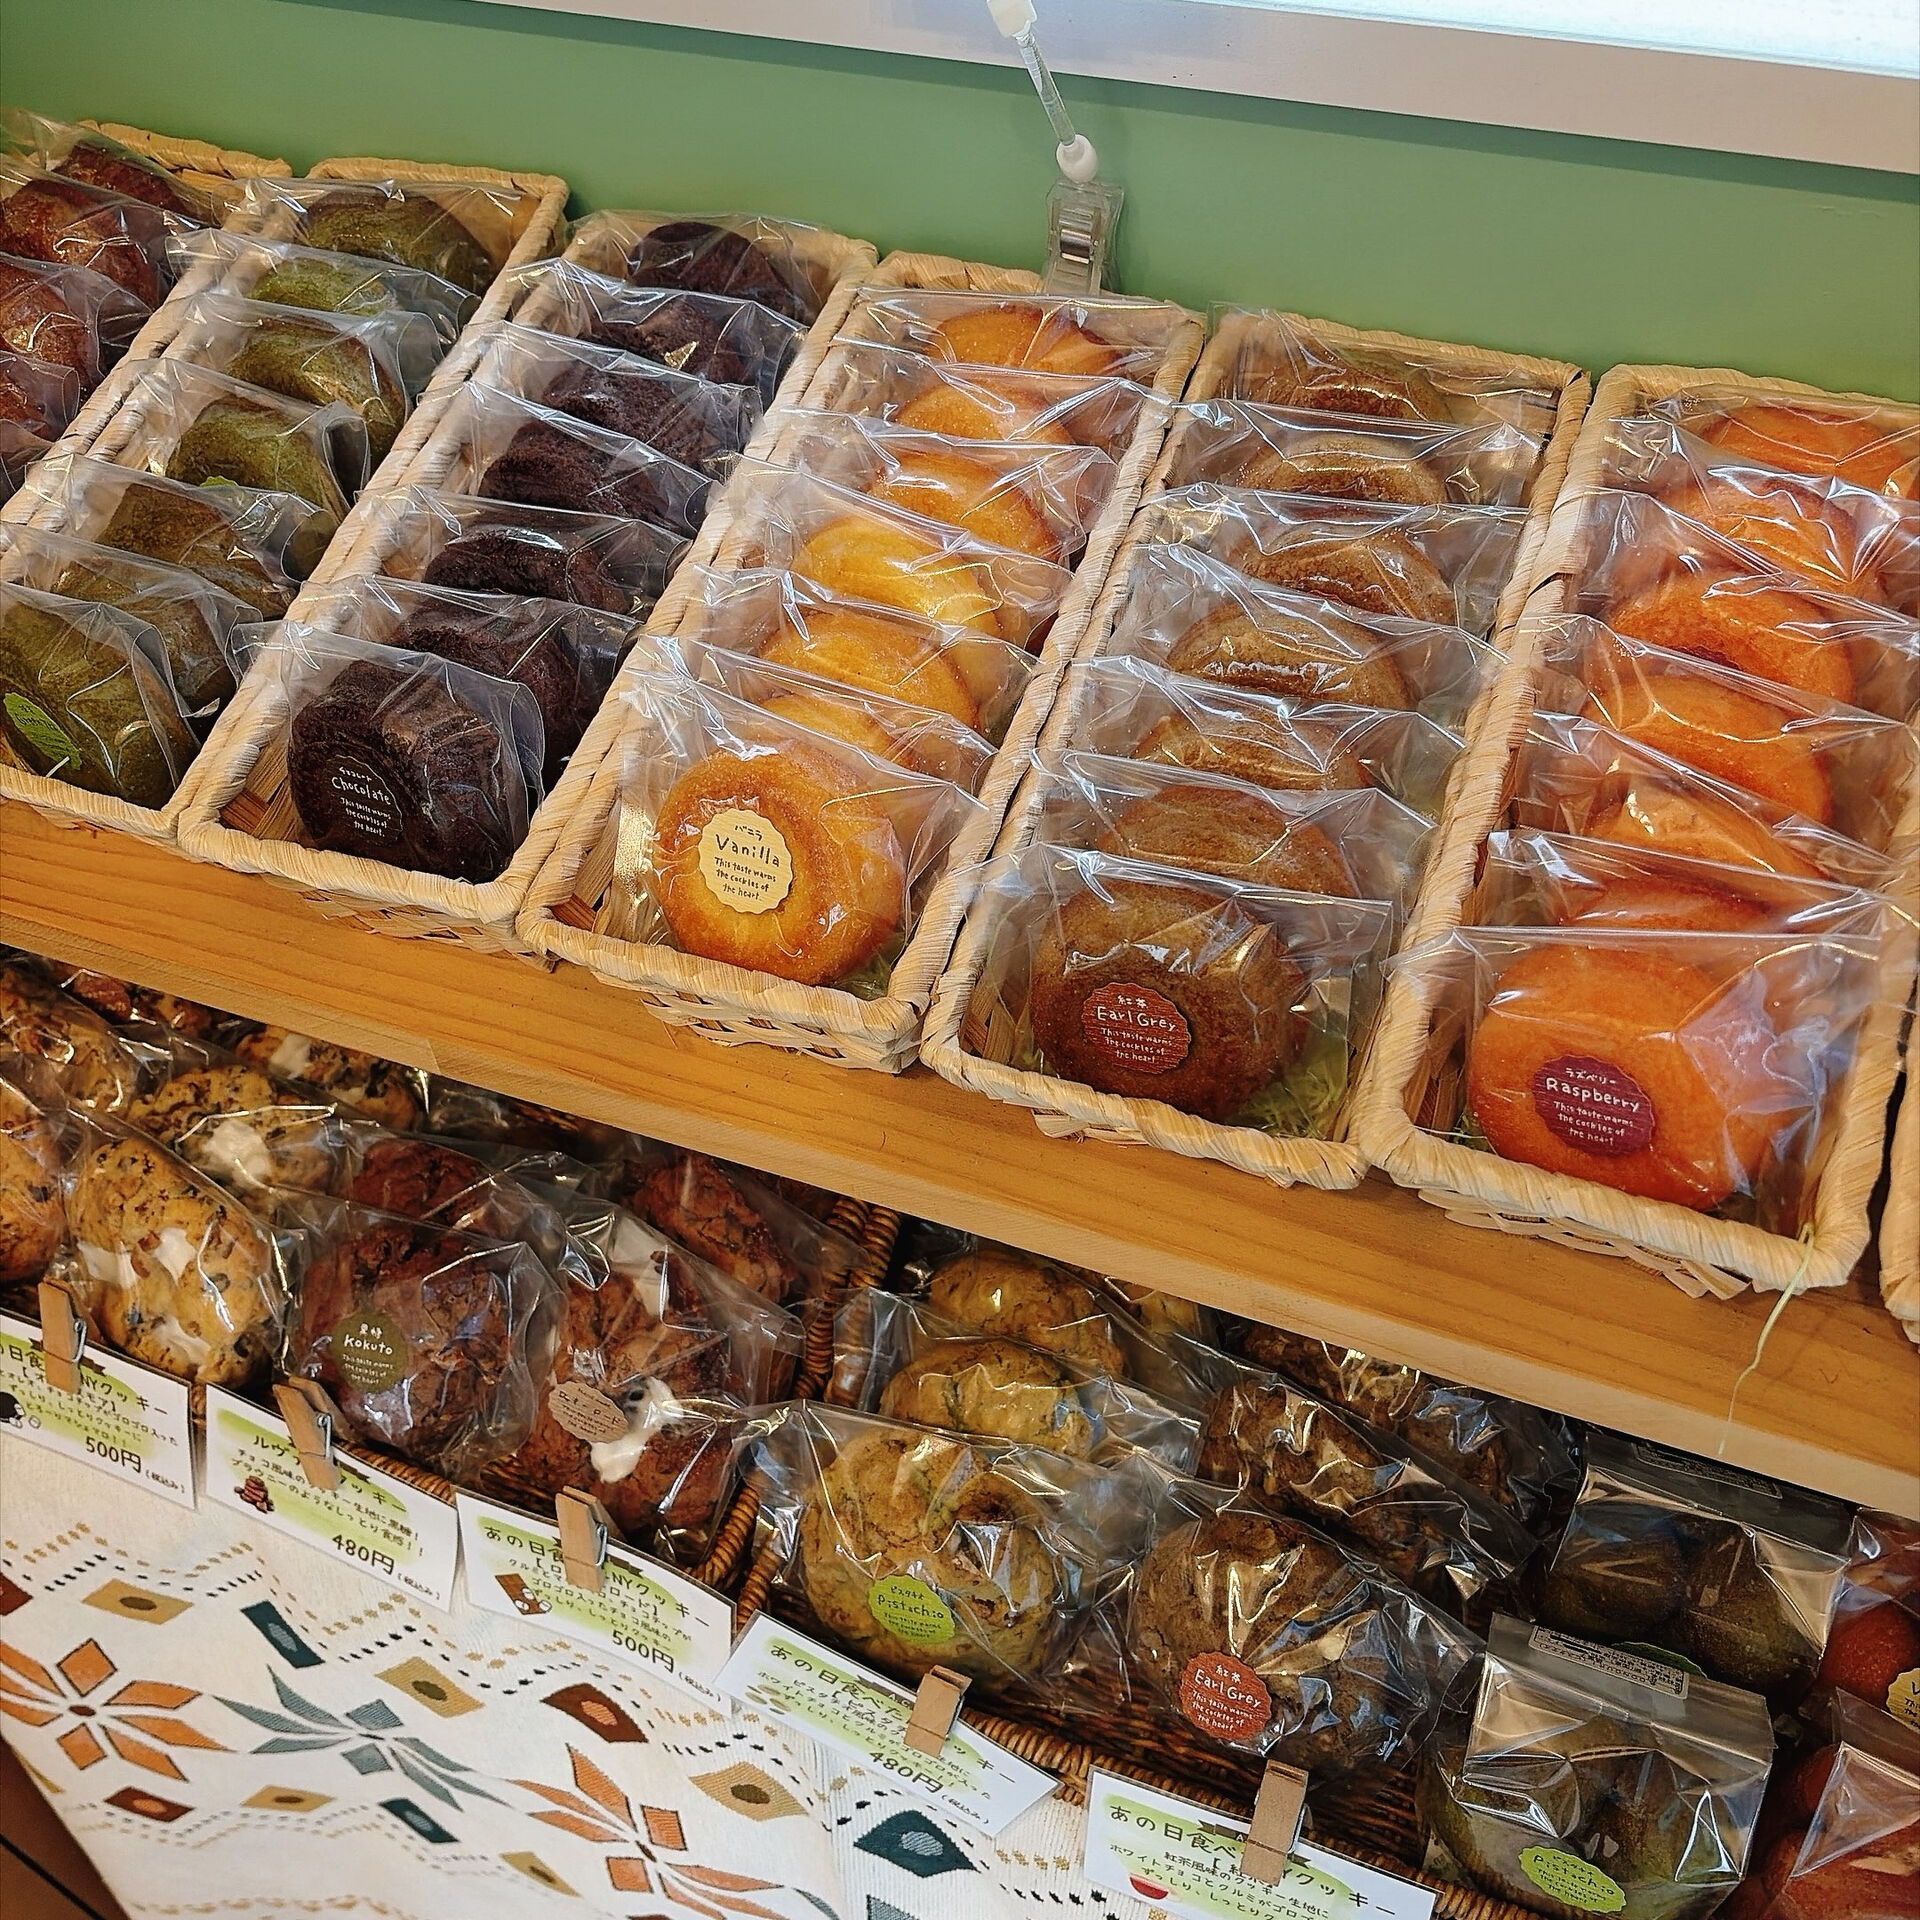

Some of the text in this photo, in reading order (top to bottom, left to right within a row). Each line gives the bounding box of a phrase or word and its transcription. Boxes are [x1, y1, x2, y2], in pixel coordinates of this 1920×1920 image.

[331, 776, 391, 805] Chocolate
[715, 833, 780, 867] Vanilla
[734, 825, 763, 841] バニラ
[714, 856, 777, 883] This taste warms
[716, 868, 770, 892] the cockles of
[722, 883, 736, 894] the
[1097, 1005, 1176, 1032] Earl Grey
[1565, 1067, 1617, 1085] ラズベリー
[1546, 1077, 1639, 1113] Raspberry
[86, 1436, 142, 1473] 500円
[332, 1533, 395, 1576] 480円
[612, 1630, 674, 1674] 500円
[1194, 1668, 1261, 1708] Earl Grey
[869, 1751, 944, 1794] 480円
[1164, 1851, 1329, 1919] 紅茶風味のクッキー生地に
